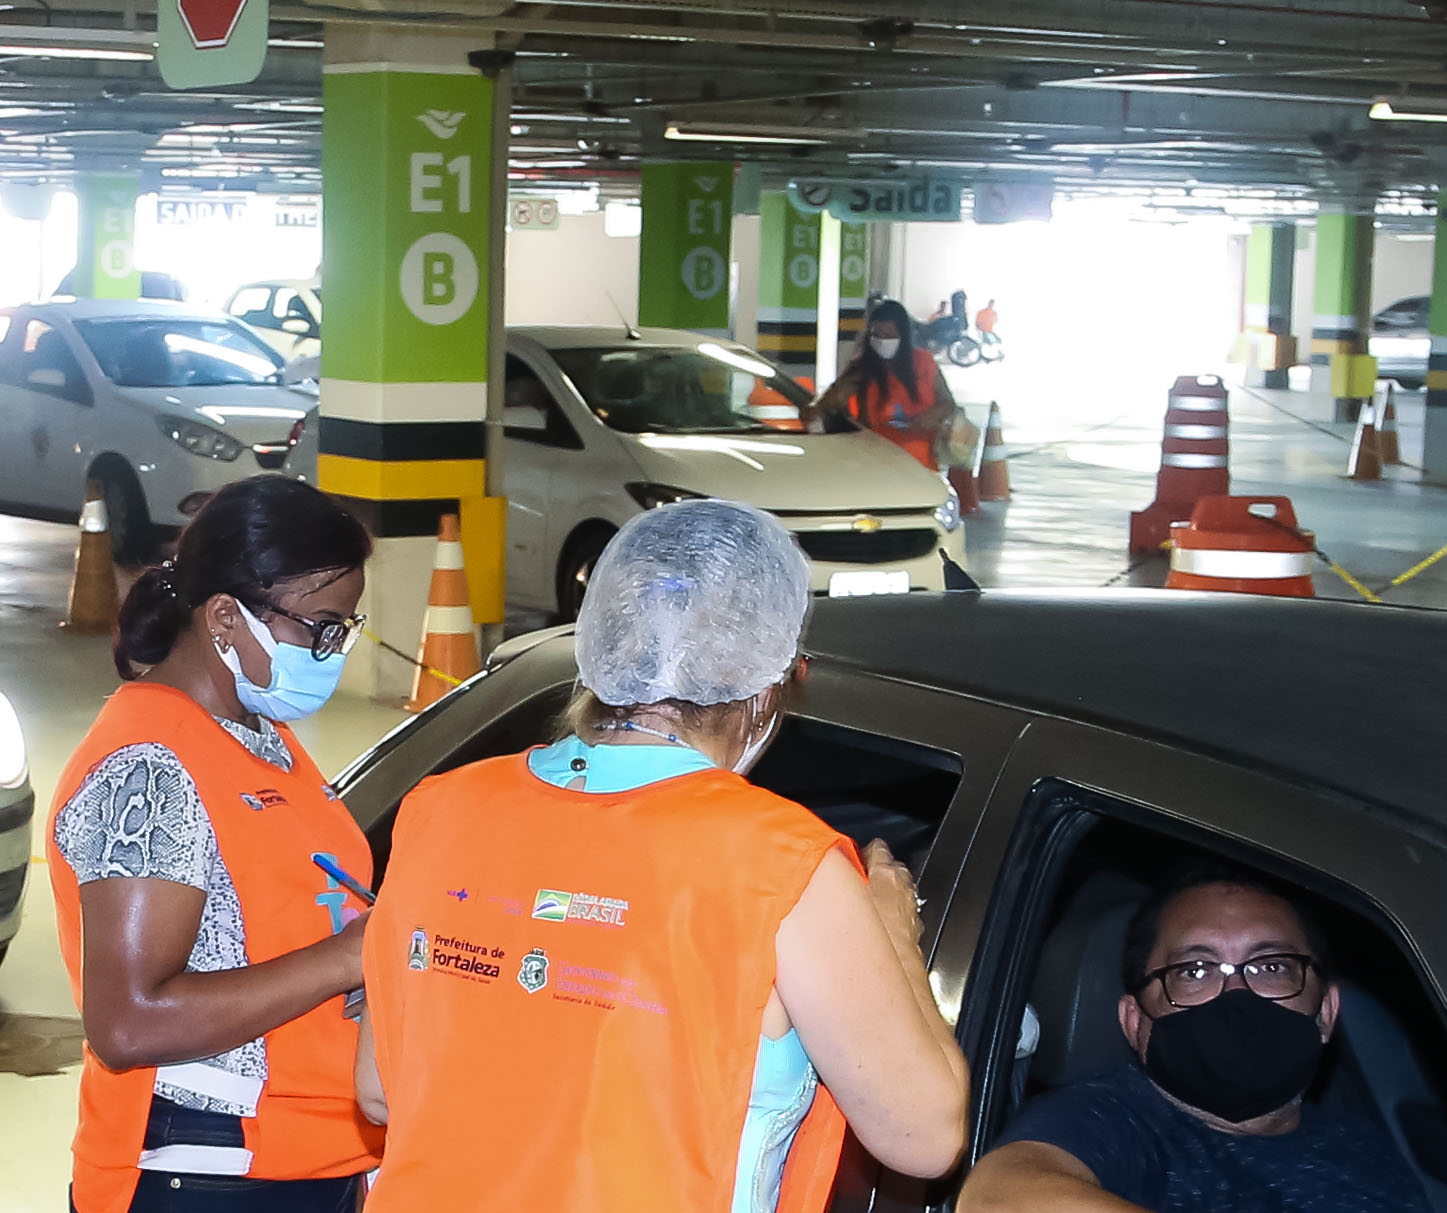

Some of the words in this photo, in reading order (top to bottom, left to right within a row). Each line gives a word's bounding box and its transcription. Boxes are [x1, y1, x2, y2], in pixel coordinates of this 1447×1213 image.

[409, 152, 471, 213] E1
[688, 200, 722, 235] E1
[793, 225, 818, 248] E1
[423, 252, 455, 306] B
[567, 902, 626, 926] BRASIL
[434, 934, 488, 957] Prefeitura
[491, 946, 505, 959] de
[432, 948, 500, 978] Fortaleza
